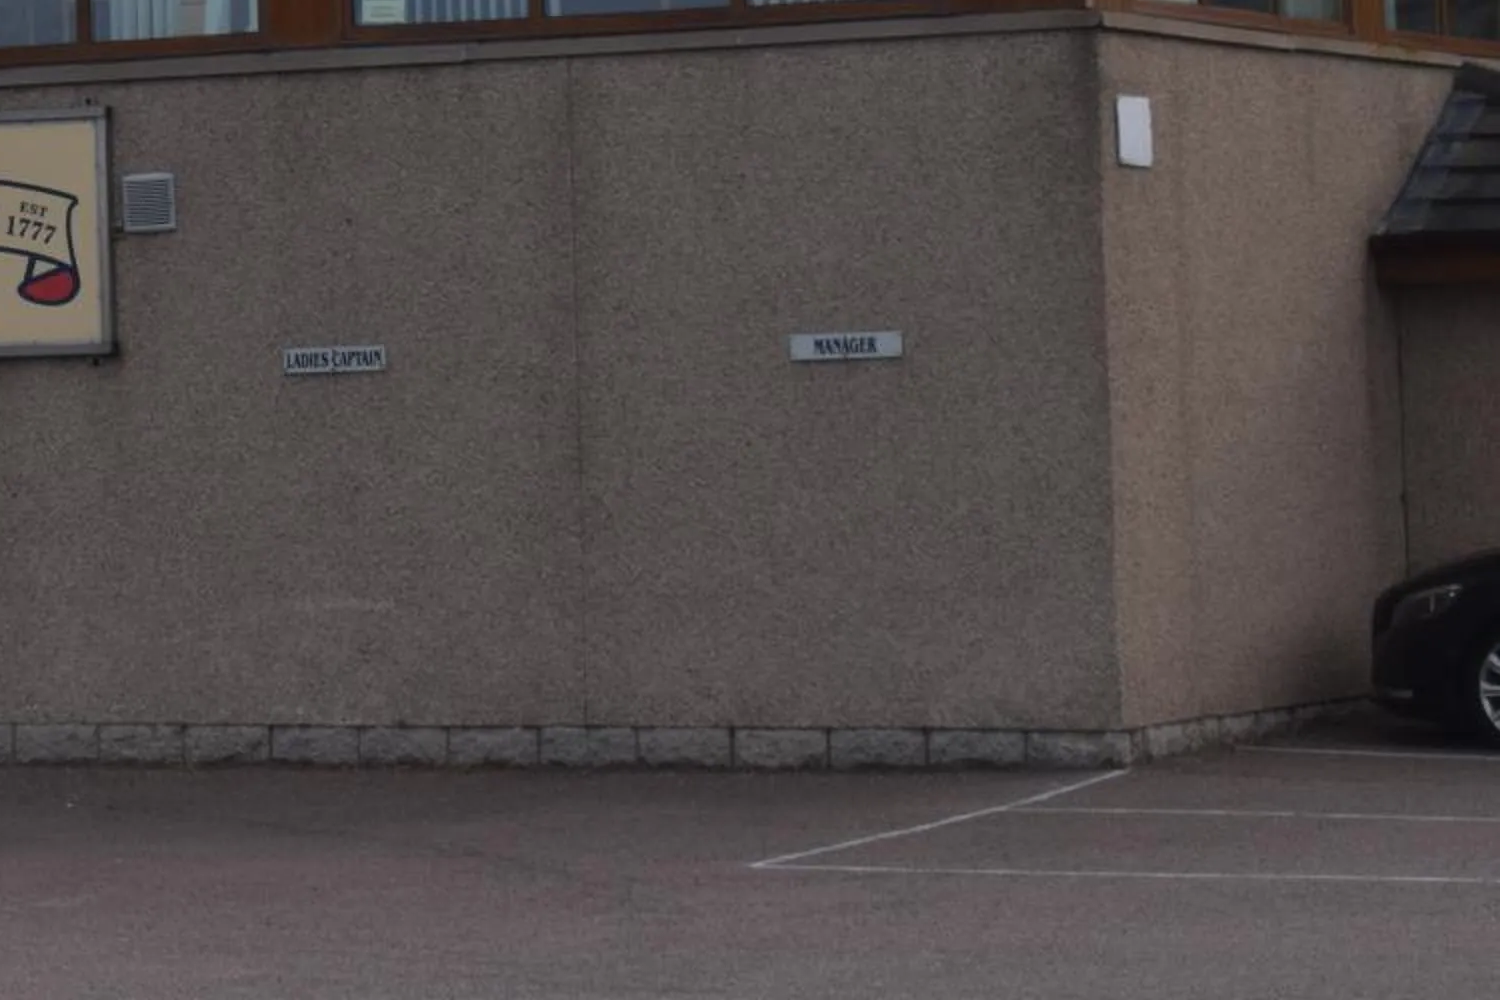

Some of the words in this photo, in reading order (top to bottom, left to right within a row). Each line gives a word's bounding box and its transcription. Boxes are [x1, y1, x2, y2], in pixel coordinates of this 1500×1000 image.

[19, 201, 49, 217] EST
[6, 215, 57, 245] 1777
[813, 336, 877, 354] MANAGER
[332, 349, 381, 367] CAPTAIN
